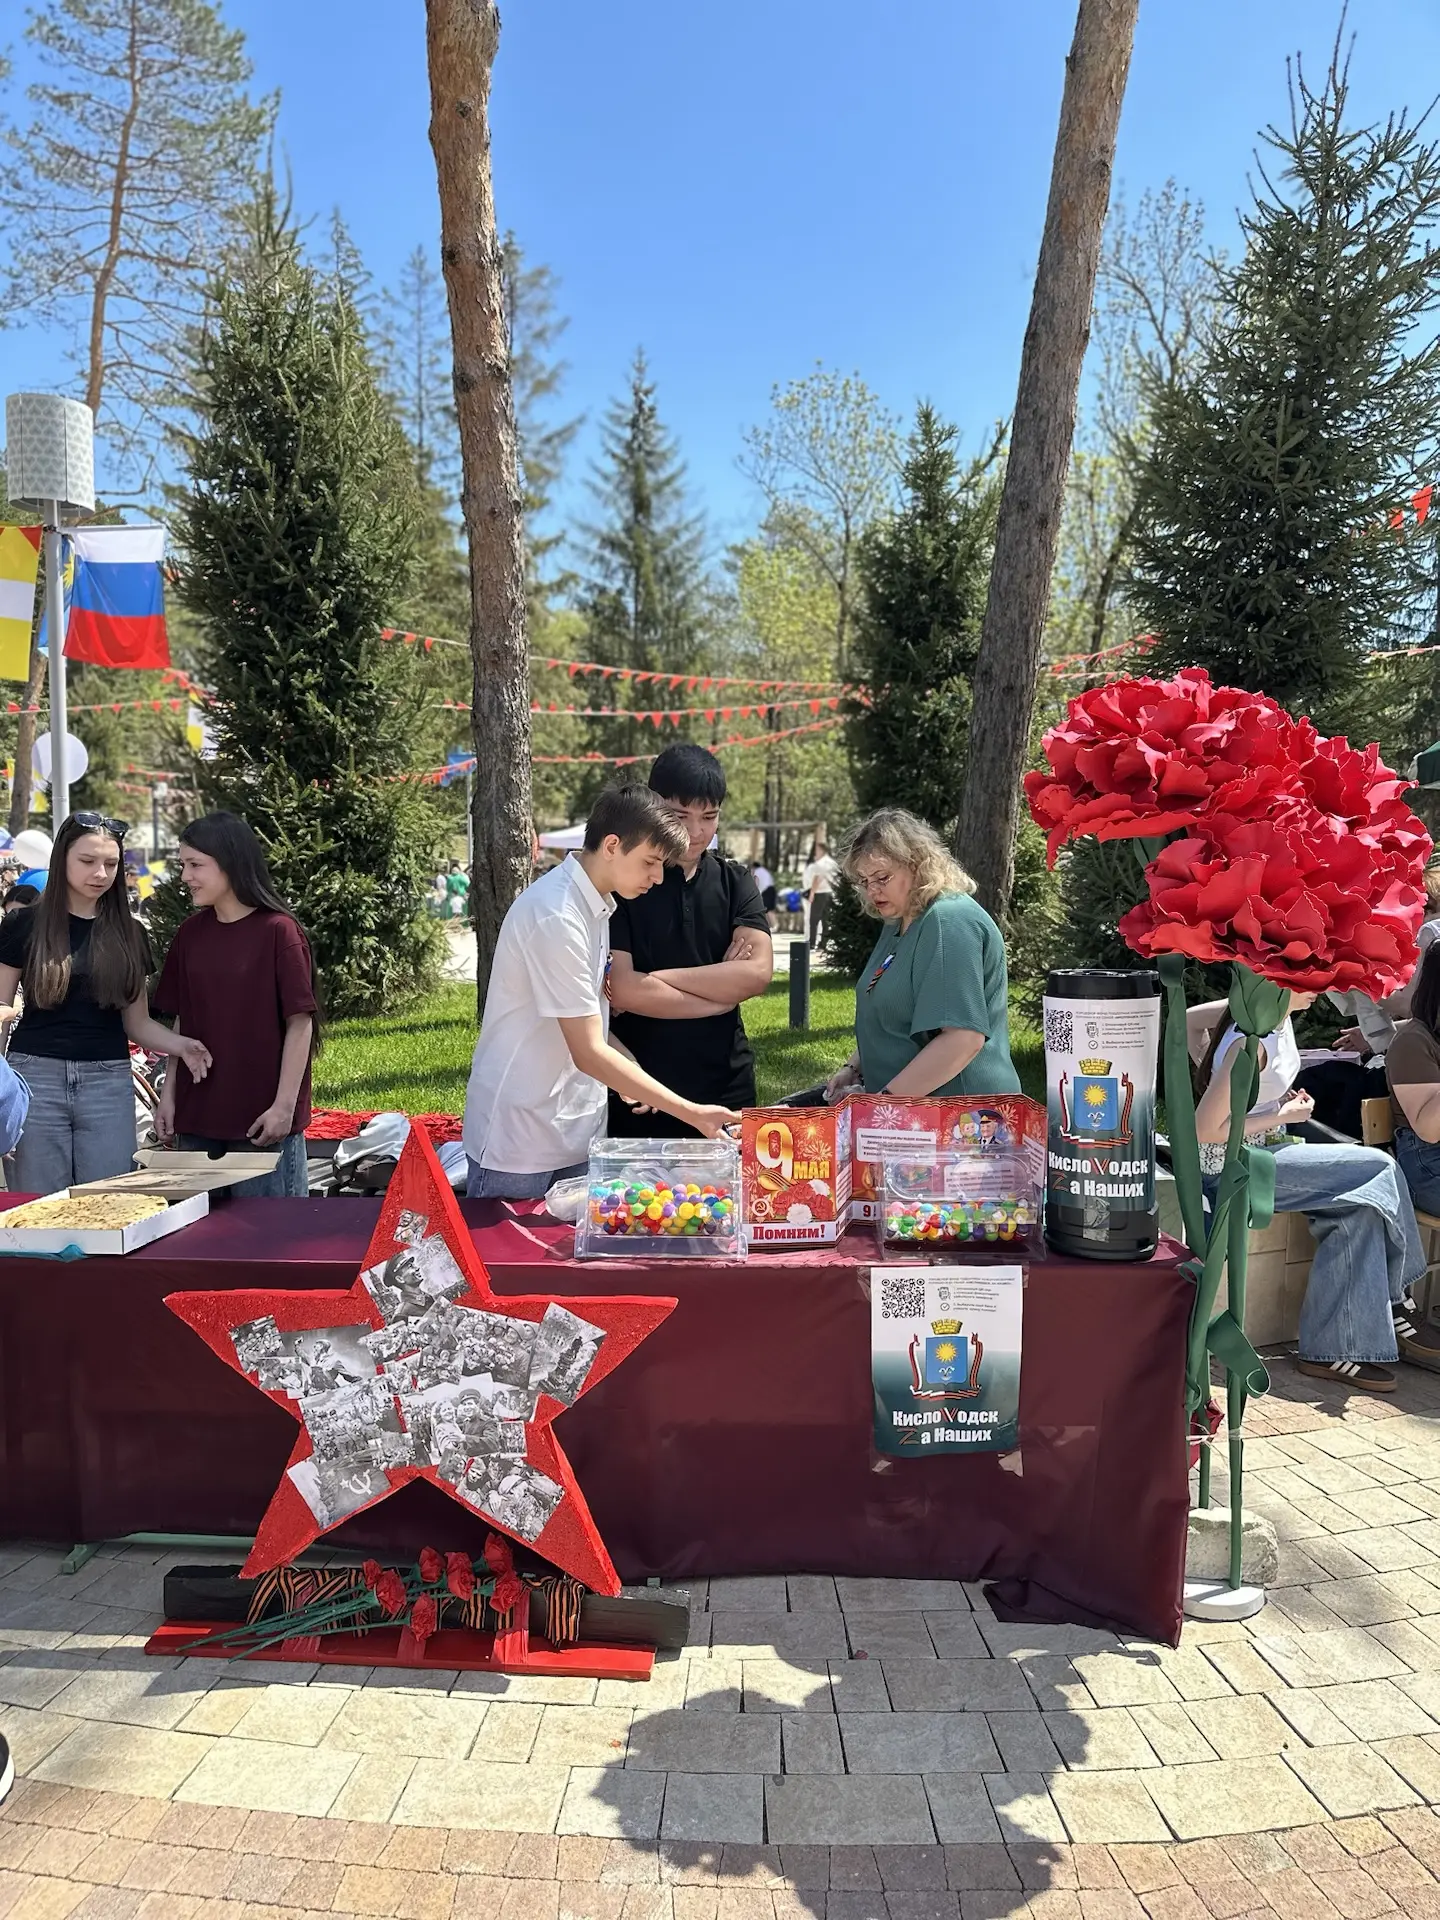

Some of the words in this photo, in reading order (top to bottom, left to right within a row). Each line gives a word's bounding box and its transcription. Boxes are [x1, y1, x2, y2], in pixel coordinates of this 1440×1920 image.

[756, 1122, 793, 1182] 9
[793, 1161, 830, 1179] МАЯ
[1084, 1180, 1145, 1197] Наших
[753, 1224, 825, 1240] Помним!
[934, 1427, 992, 1443] Наших
